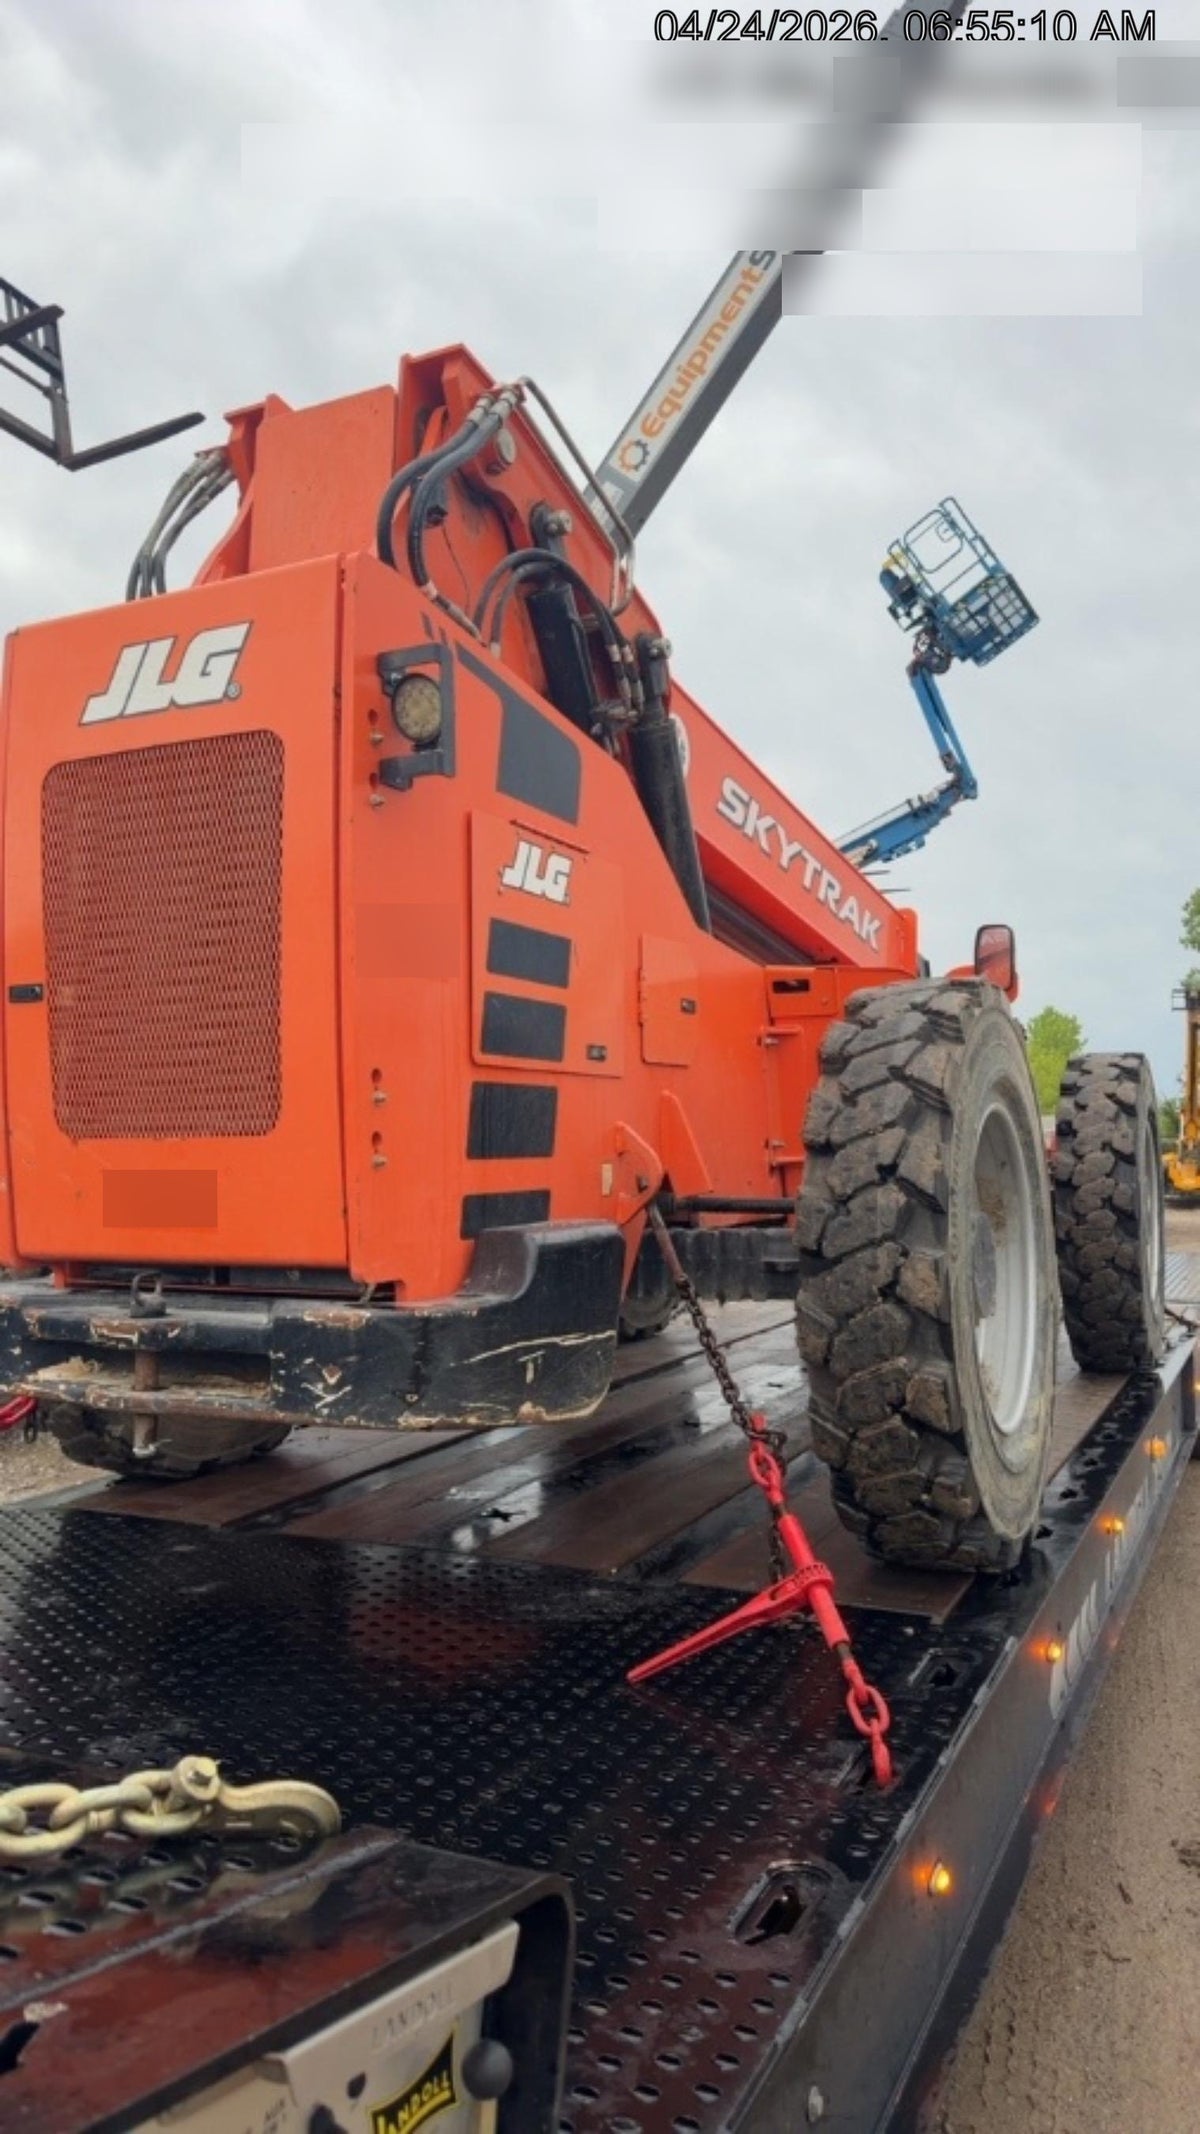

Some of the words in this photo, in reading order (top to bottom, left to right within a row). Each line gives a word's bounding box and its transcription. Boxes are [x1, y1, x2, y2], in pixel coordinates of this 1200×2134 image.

[79, 621, 253, 726] JLG
[501, 839, 573, 905] JLG
[716, 776, 882, 952] SKYTRAK
